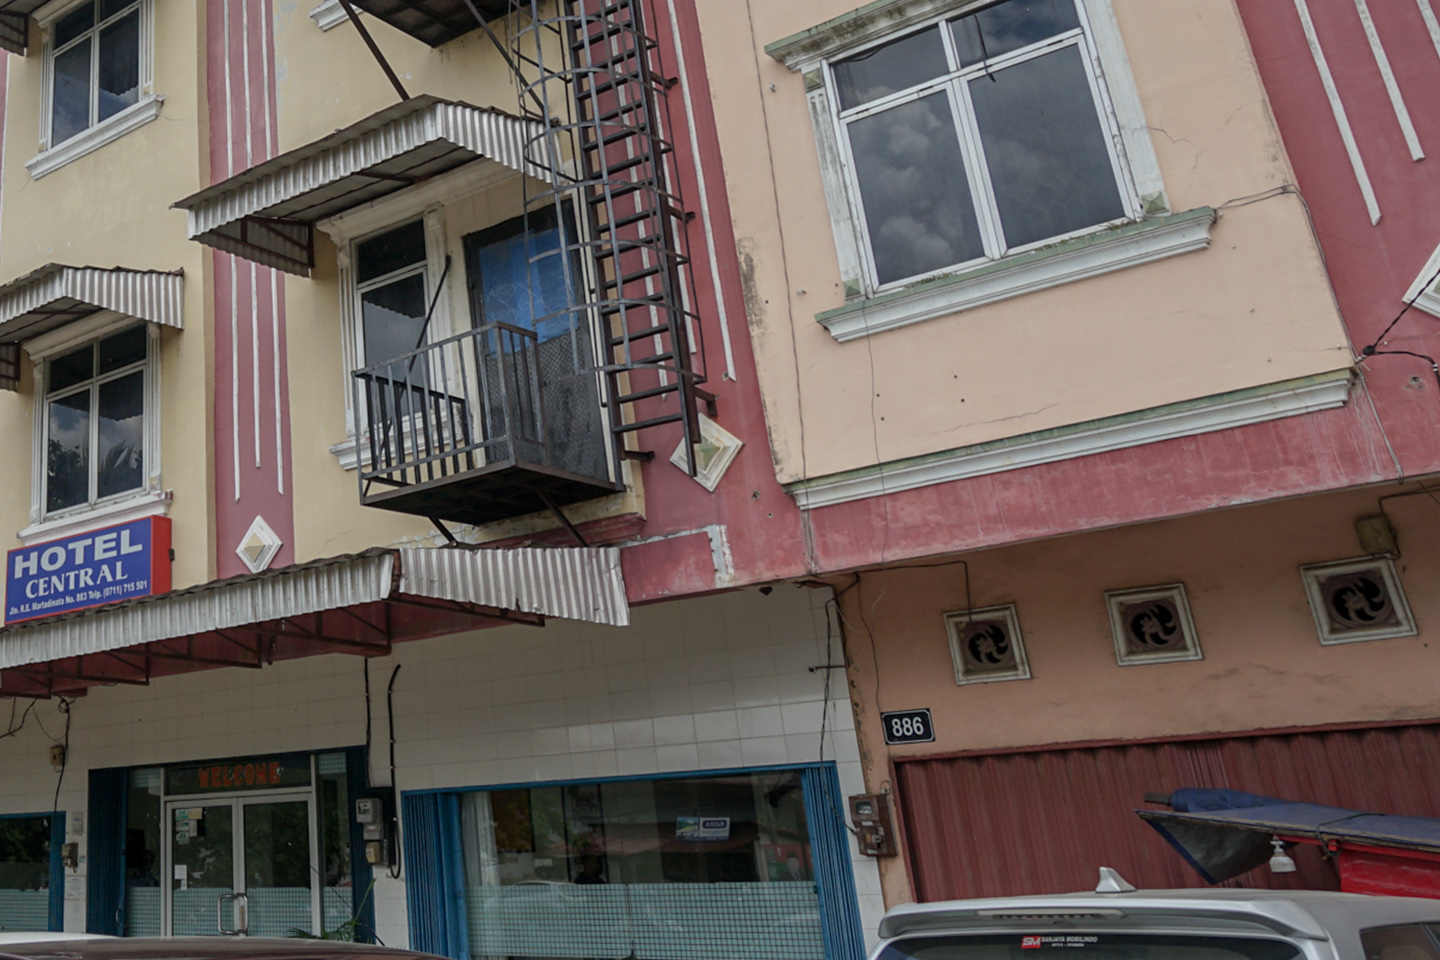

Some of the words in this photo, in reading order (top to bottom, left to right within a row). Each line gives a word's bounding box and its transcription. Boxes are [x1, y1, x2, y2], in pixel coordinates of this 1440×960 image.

[14, 529, 143, 579] HOTEL
[25, 561, 128, 599] CENTRAL
[9, 606, 19, 615] Jln.
[20, 603, 31, 613] R.E.
[31, 598, 64, 611] Martadinata
[65, 595, 75, 604] No.
[76, 592, 87, 602] 883
[88, 589, 102, 600] Telp.
[103, 585, 122, 598] (0711)
[123, 582, 135, 592] 715
[136, 580, 148, 589] 501
[891, 716, 924, 737] 886
[198, 761, 280, 788] WELCOME
[1022, 937, 1041, 946] SM
